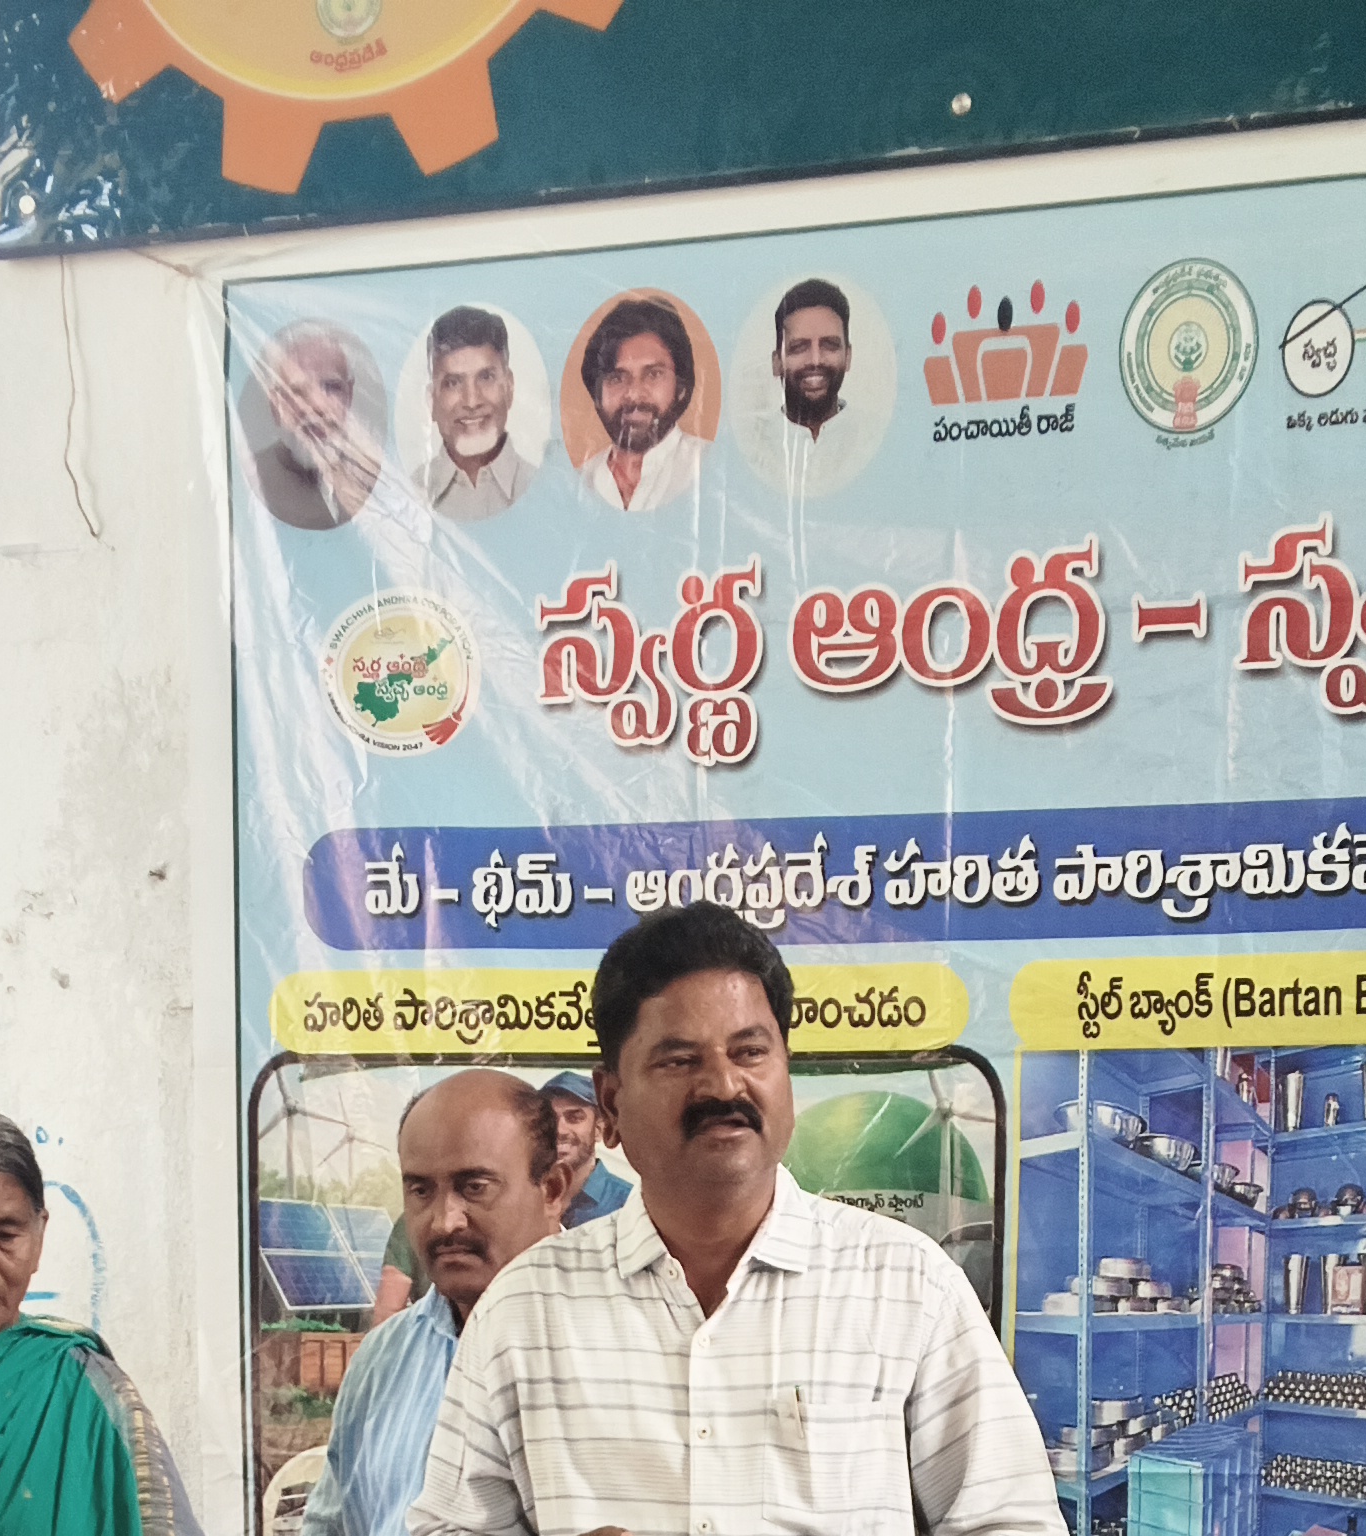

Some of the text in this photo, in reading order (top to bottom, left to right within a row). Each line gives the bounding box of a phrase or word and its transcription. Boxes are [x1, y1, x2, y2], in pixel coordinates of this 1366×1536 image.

[932, 403, 1077, 443] పంచాయితీ రాజ్
[1317, 407, 1359, 425] అడుగు
[539, 560, 759, 764] స్వర్ణ
[790, 536, 1112, 725] ఆంధ్ర
[364, 840, 420, 915] మే
[884, 833, 1040, 908] హరిత
[302, 988, 385, 1034] హరిత
[1076, 970, 1124, 1039] స్టీల్
[1129, 970, 1215, 1037] బ్యాంక్
[1221, 974, 1344, 1024] (Bartan
